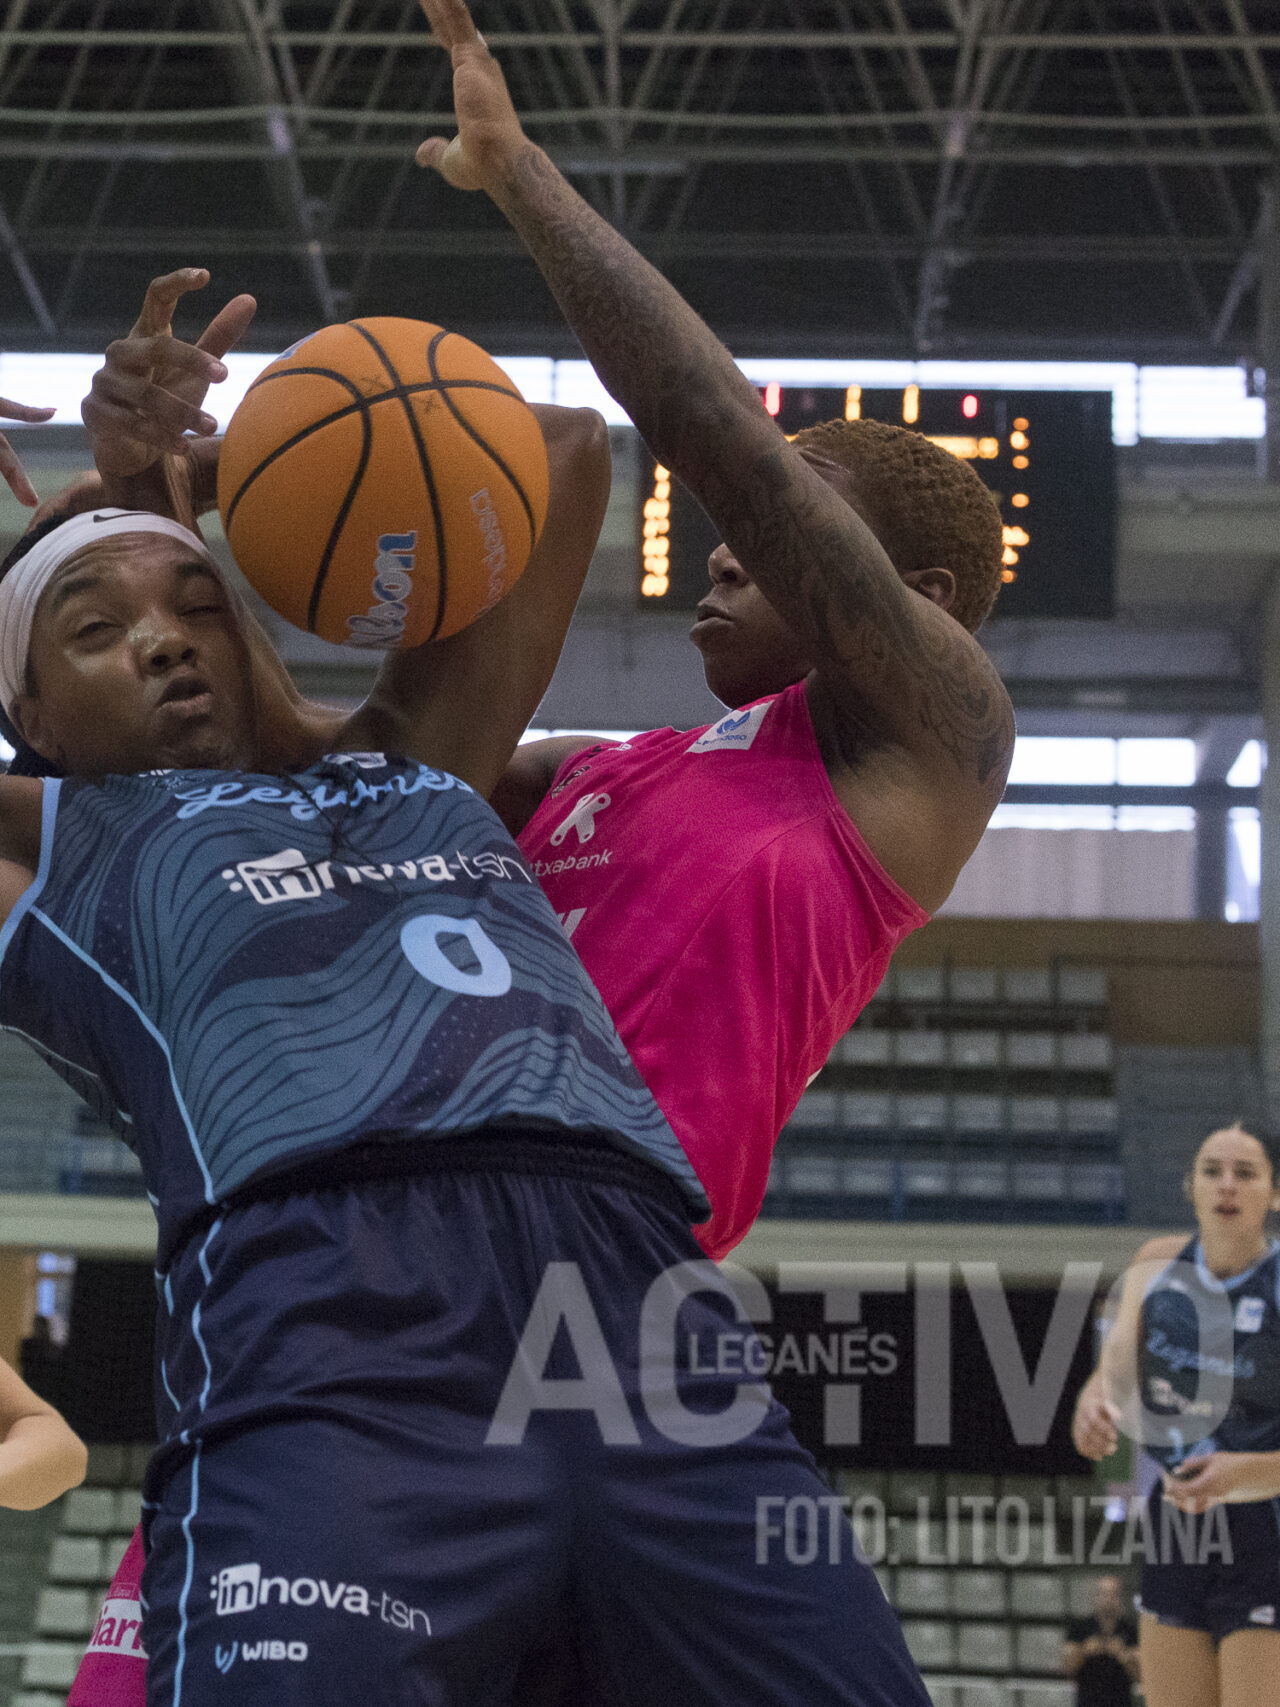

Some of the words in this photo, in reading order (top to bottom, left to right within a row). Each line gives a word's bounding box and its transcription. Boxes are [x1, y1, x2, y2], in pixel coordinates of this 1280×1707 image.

[529, 849, 613, 877] txabank
[401, 914, 513, 997] 0
[242, 1640, 309, 1662] WIBO
